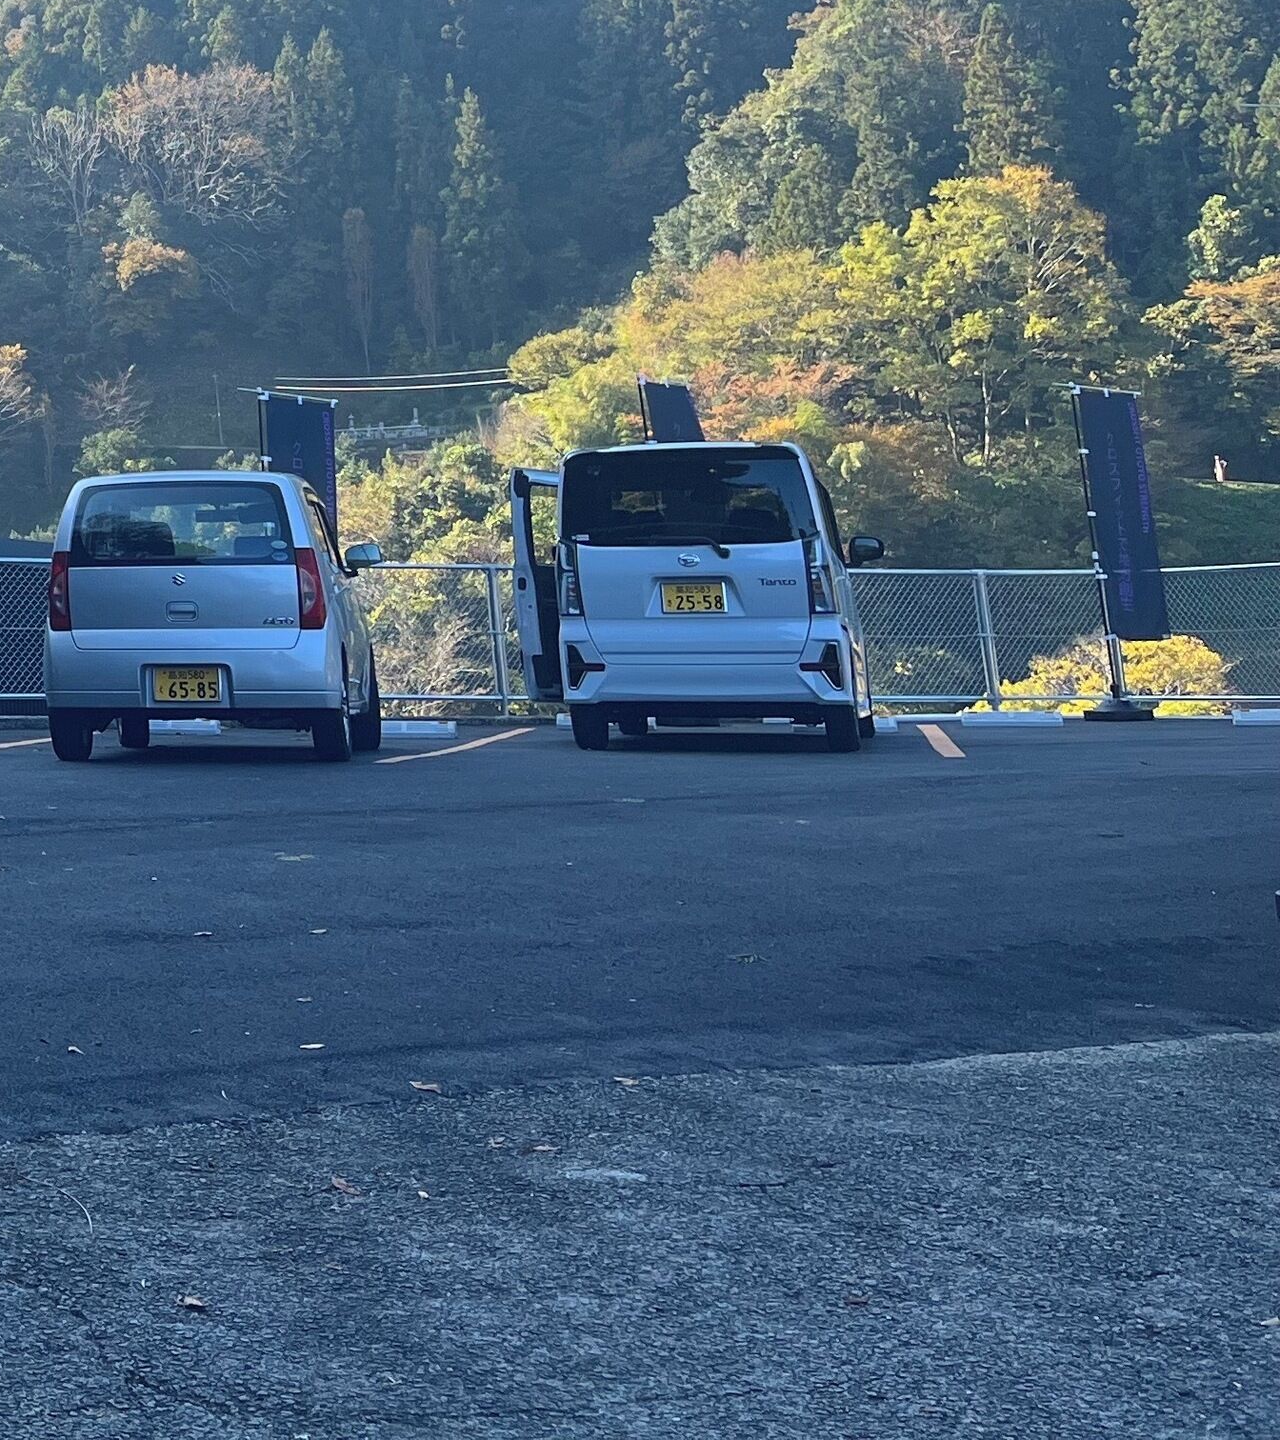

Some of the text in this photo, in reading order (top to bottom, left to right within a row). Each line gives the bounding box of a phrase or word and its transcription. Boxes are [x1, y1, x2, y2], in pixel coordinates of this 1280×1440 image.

[759, 578, 797, 586] Tanto
[676, 595, 723, 611] 25-58
[169, 681, 218, 699] 65-85
